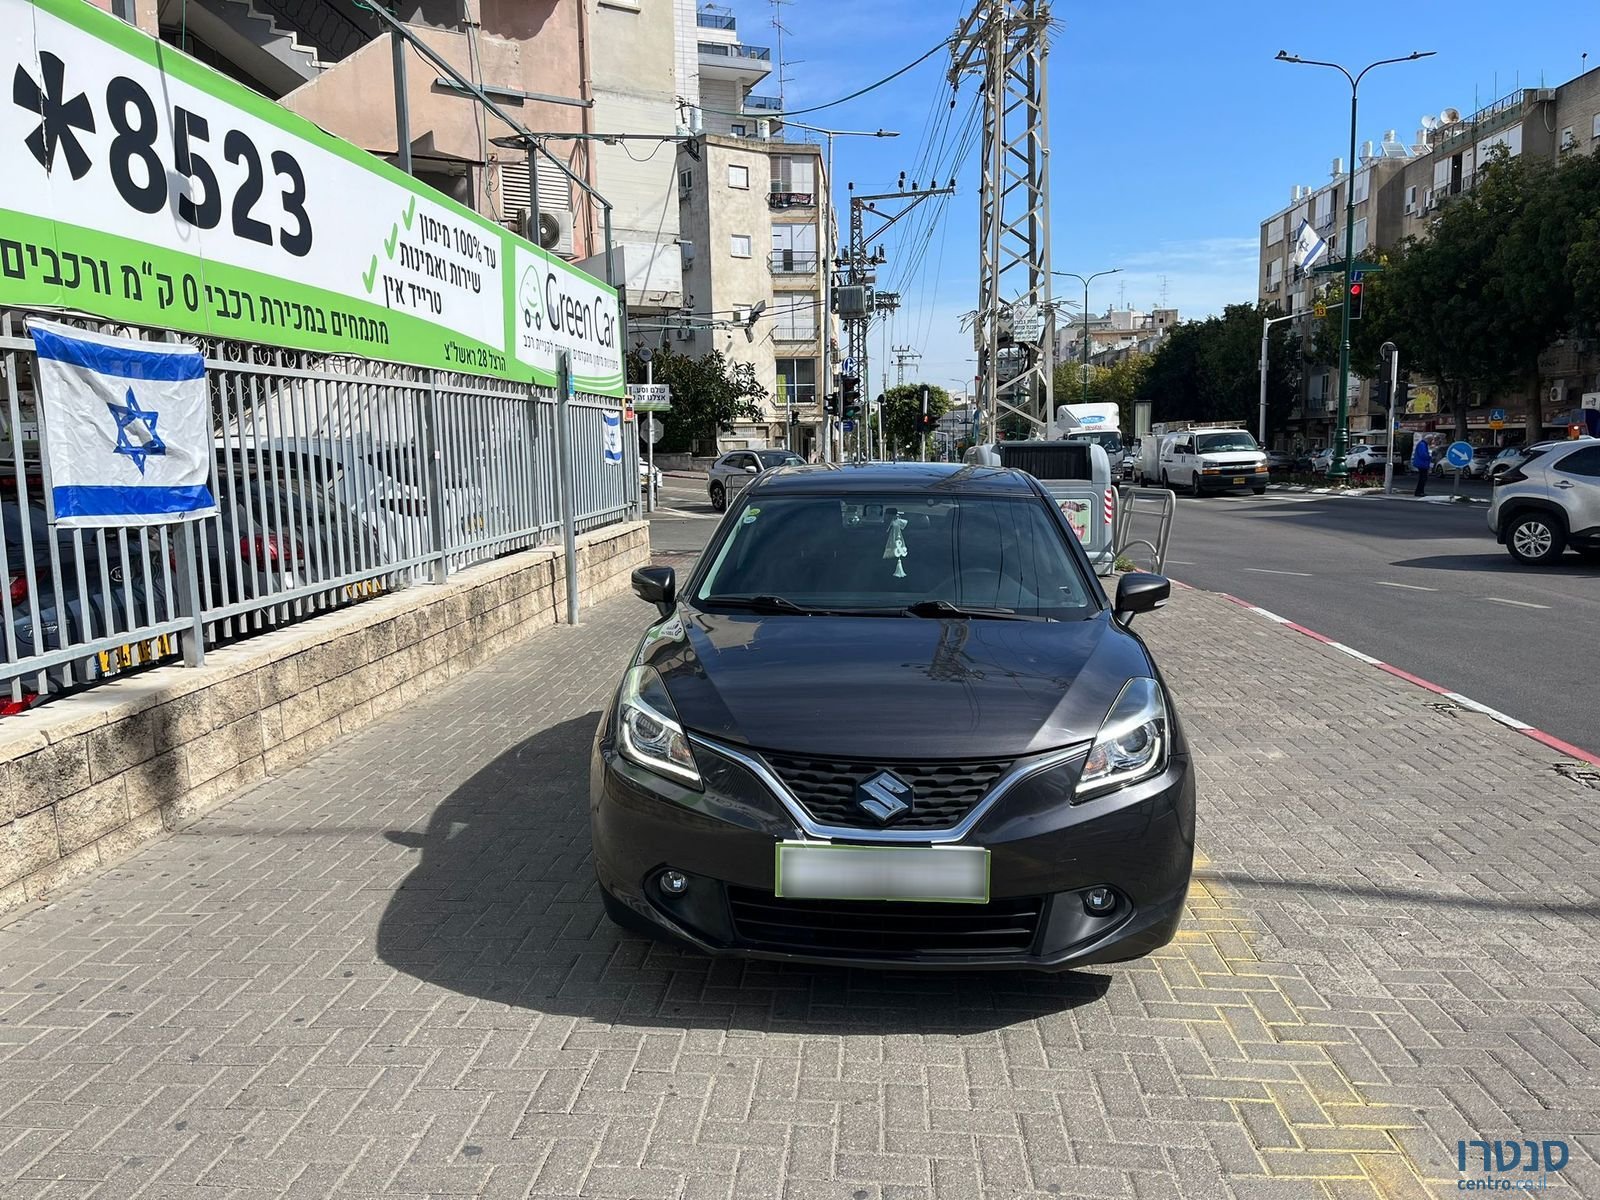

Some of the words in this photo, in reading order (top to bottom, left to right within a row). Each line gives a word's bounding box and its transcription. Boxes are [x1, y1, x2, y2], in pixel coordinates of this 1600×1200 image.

[419, 213, 451, 249] מימון
[453, 228, 482, 263] 100%
[0, 239, 112, 296] ורכבים
[399, 242, 447, 281] ואמינות
[483, 245, 496, 269] עד
[182, 273, 199, 312] 0
[383, 275, 406, 309] אין
[449, 262, 481, 294] שירות
[205, 285, 255, 321] רכבי
[260, 295, 327, 334] במכירת
[407, 283, 442, 315] טרייד
[545, 273, 593, 341] Green
[594, 296, 615, 349] Car
[330, 310, 389, 345] מתמחים
[523, 334, 535, 349] רכב
[478, 348, 488, 368] 28
[489, 350, 507, 371] הרצל
